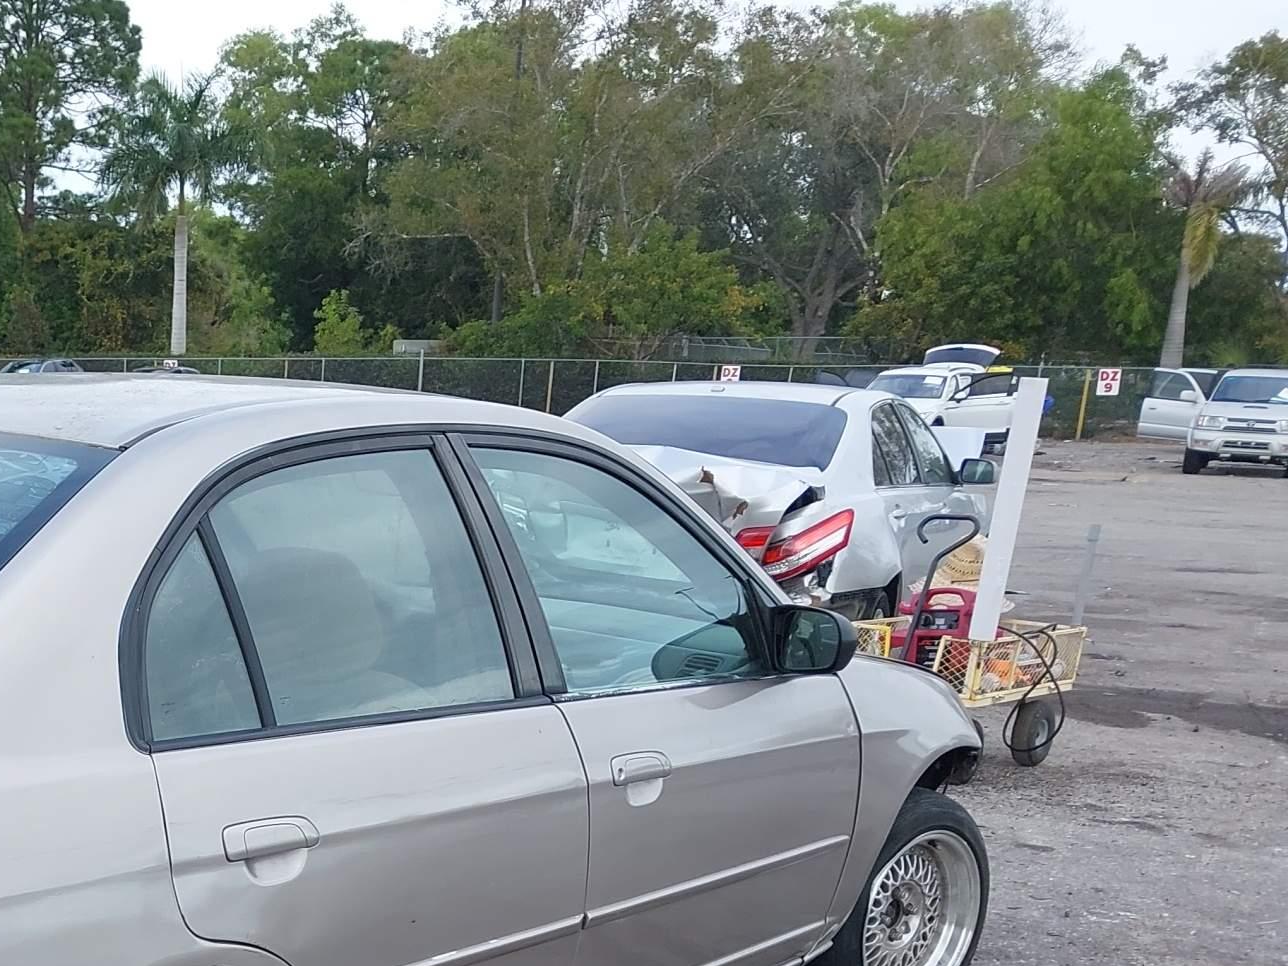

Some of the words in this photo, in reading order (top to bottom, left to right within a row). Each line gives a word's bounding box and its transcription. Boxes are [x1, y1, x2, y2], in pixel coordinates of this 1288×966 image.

[723, 367, 739, 378] DZ
[1101, 371, 1119, 381] DZ
[1104, 383, 1113, 392] 9
